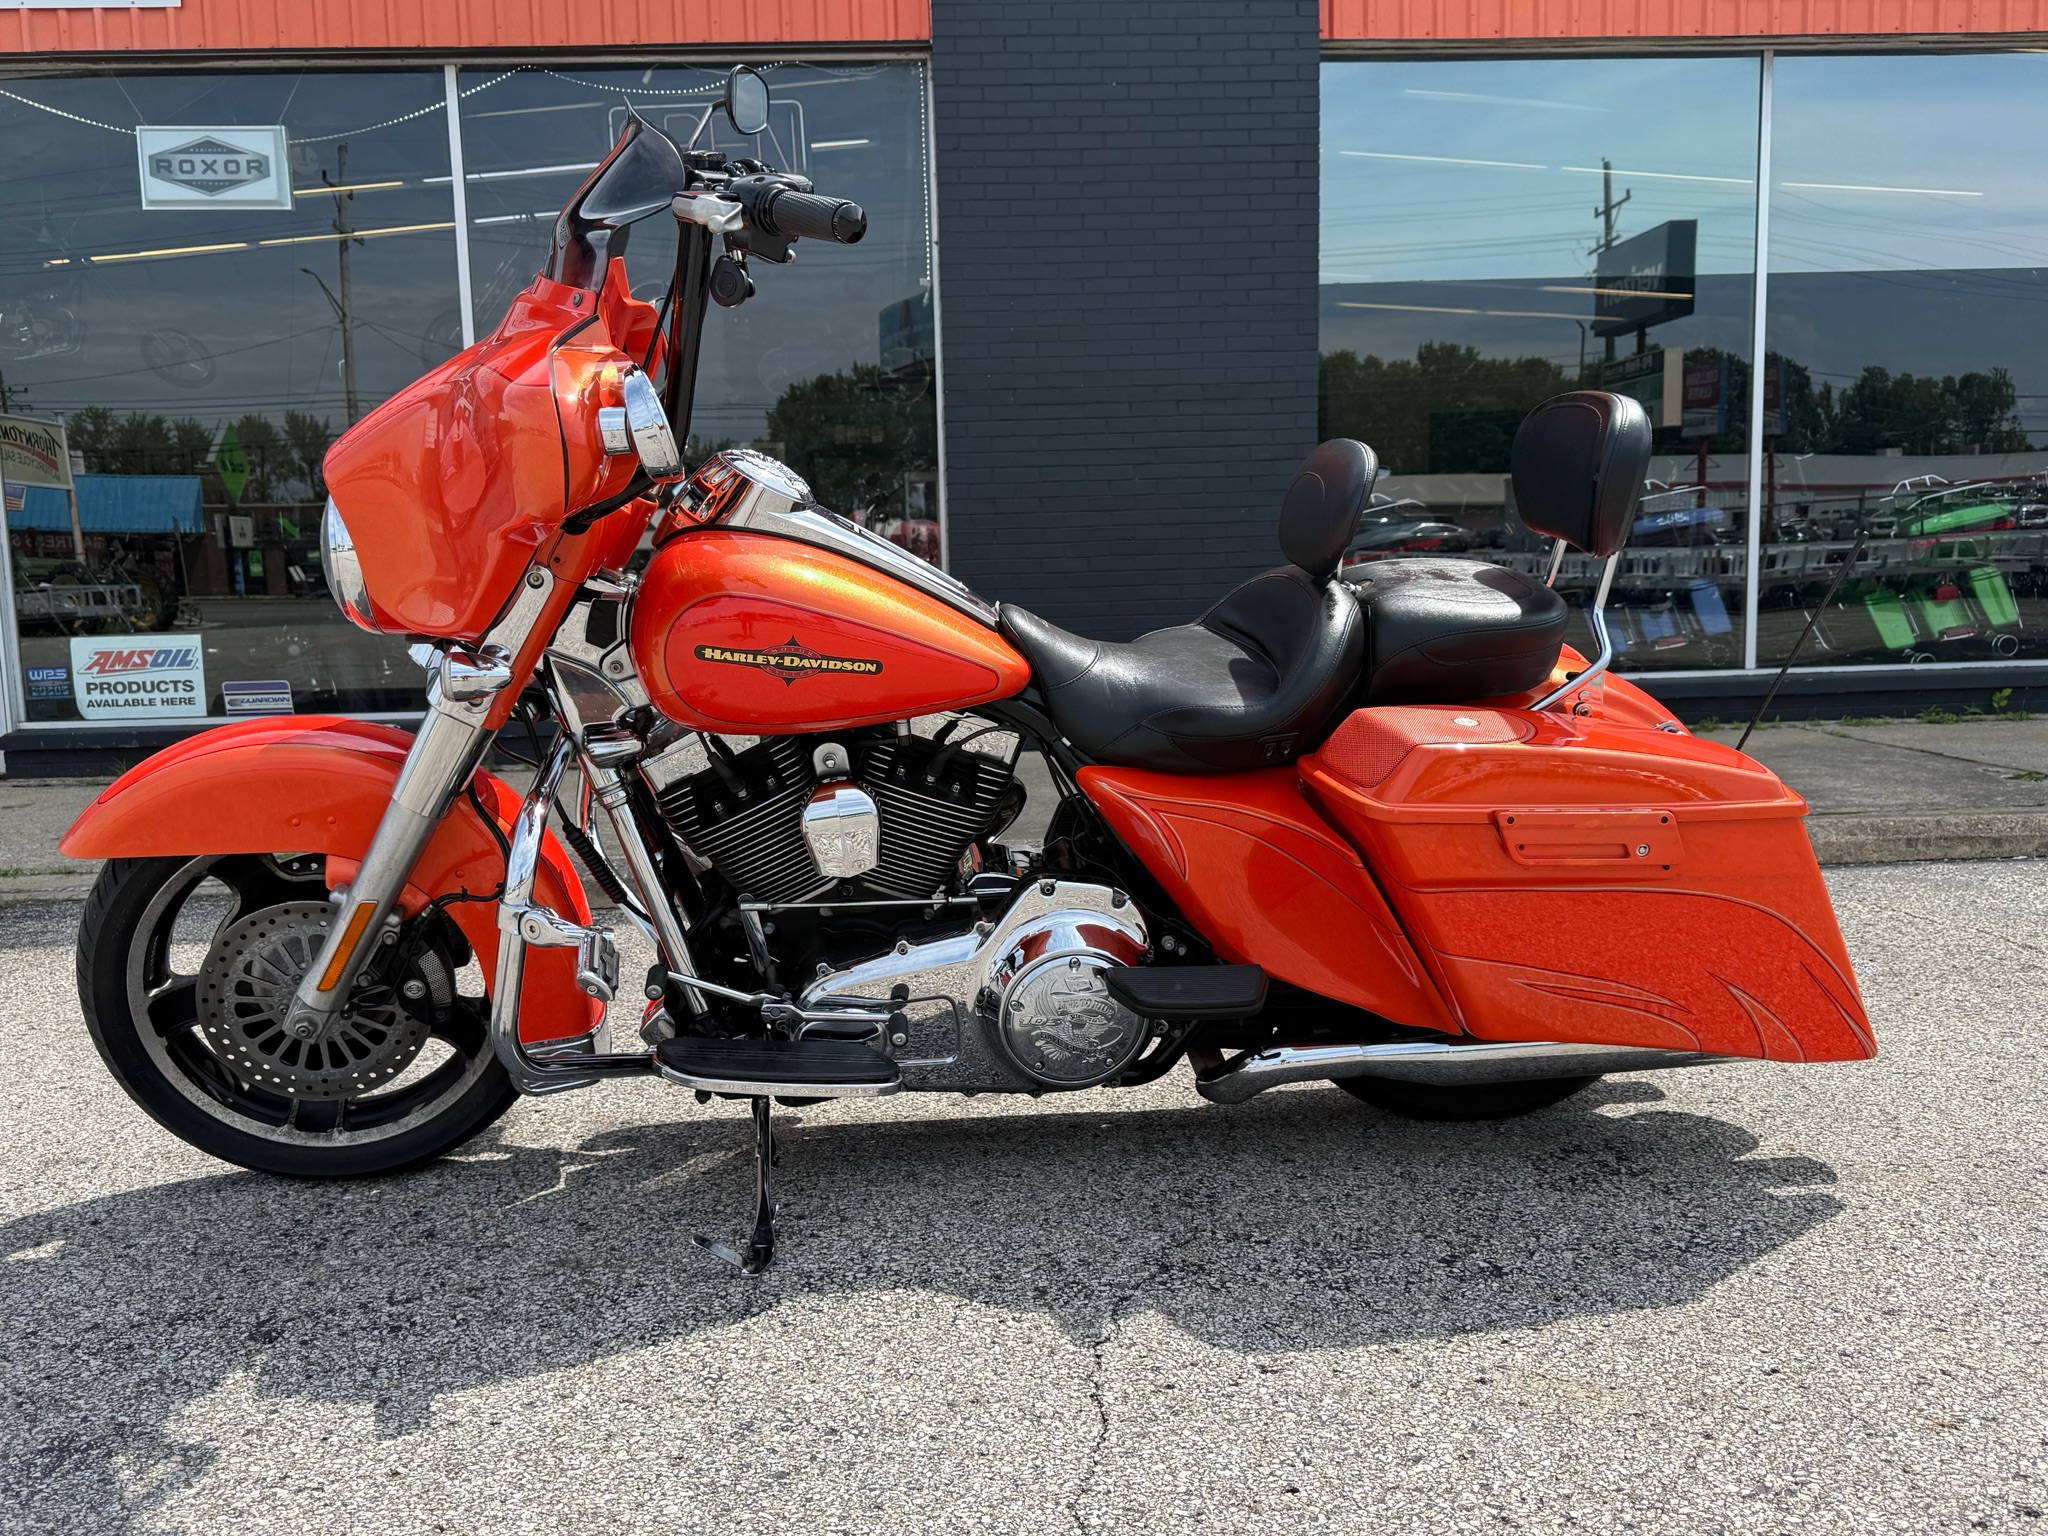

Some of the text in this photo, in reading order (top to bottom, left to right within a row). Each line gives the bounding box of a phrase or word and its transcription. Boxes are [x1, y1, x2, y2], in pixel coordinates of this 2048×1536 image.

[155, 158, 264, 175] ROXOR
[85, 648, 197, 674] AMSOIL
[702, 648, 877, 673] HARLEY-DAVIDSON
[28, 669, 68, 680] WPS
[85, 680, 195, 695] PRODUCTS
[86, 696, 196, 708] AVAILABLE HERE
